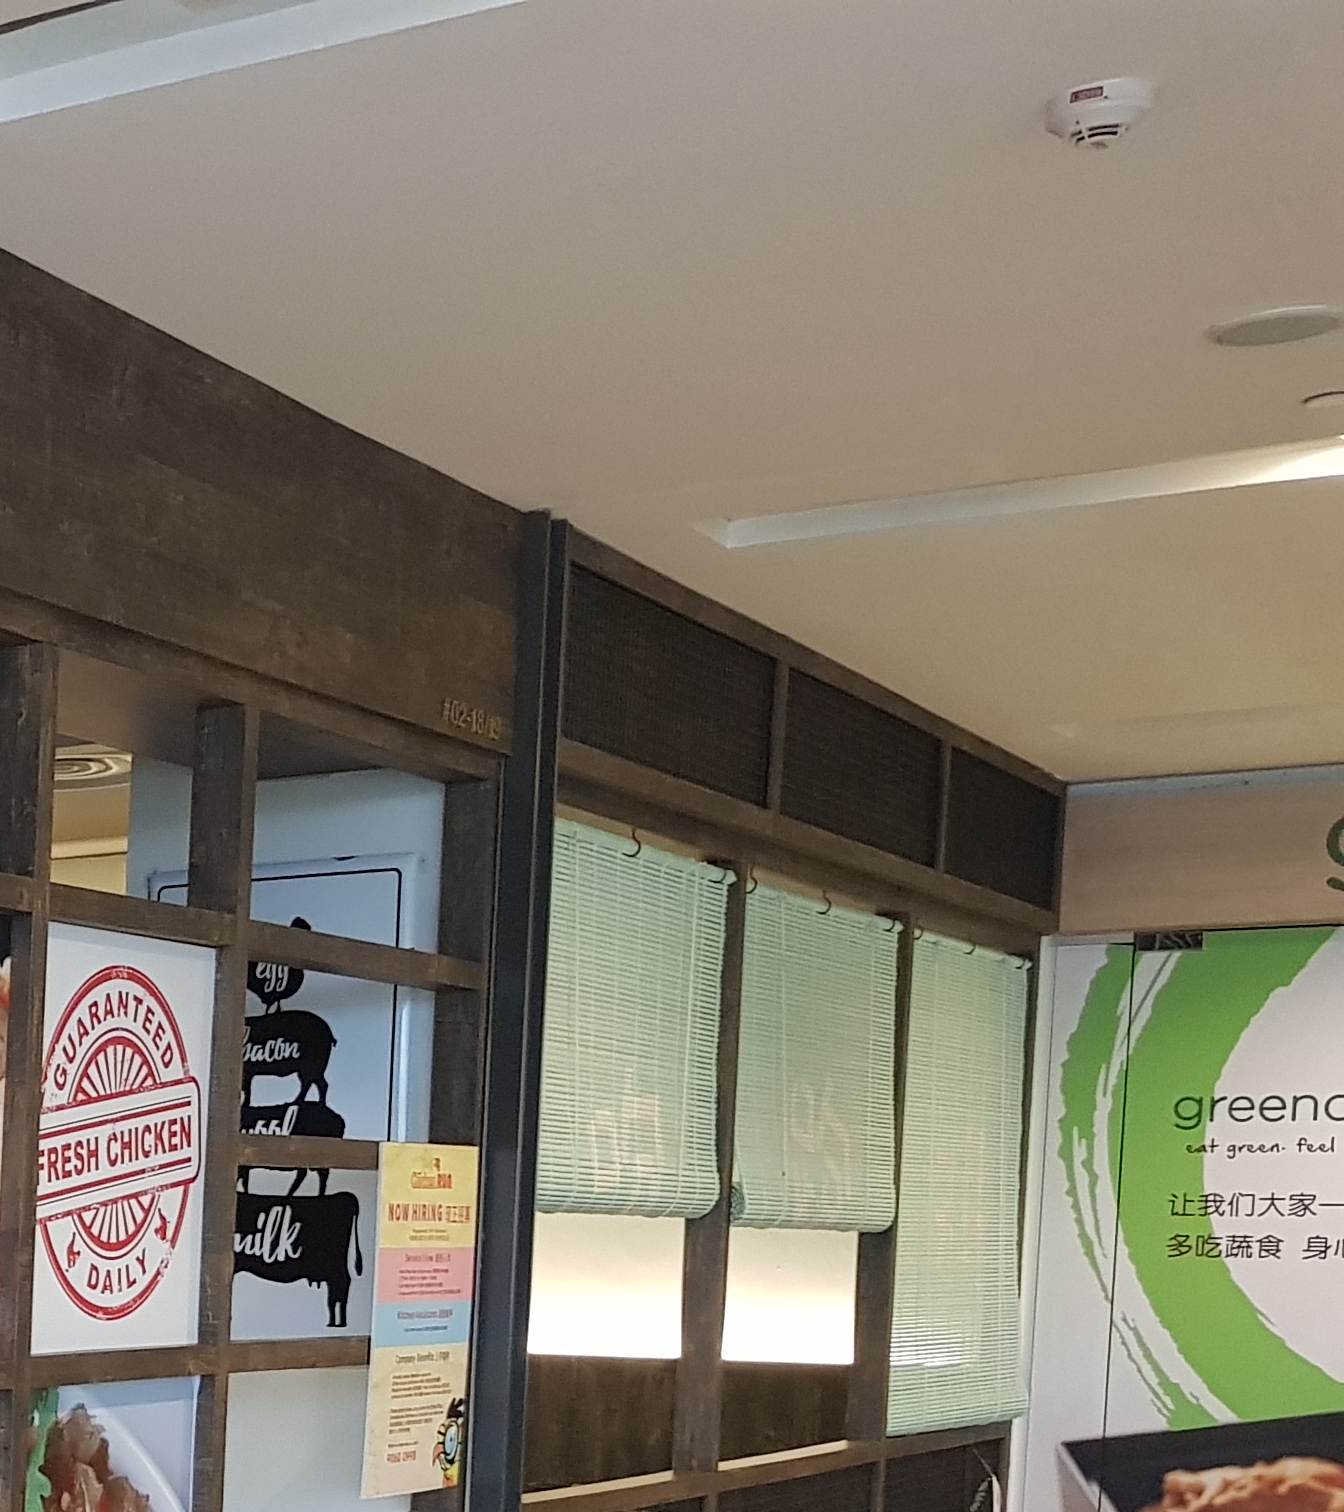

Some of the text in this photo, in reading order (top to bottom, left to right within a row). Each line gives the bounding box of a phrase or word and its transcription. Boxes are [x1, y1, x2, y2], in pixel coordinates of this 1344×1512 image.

[255, 961, 289, 993] egg
[53, 990, 175, 1092] GUARANTEED
[37, 1113, 193, 1187] FRESH CHICKEN
[1185, 1137, 1220, 1154] eat
[1296, 1136, 1336, 1154] feel
[388, 1203, 410, 1222] NOW
[411, 1203, 444, 1222] HIRING
[1166, 1233, 1285, 1260] 多吃蔬食
[86, 1247, 149, 1296] DAILY
